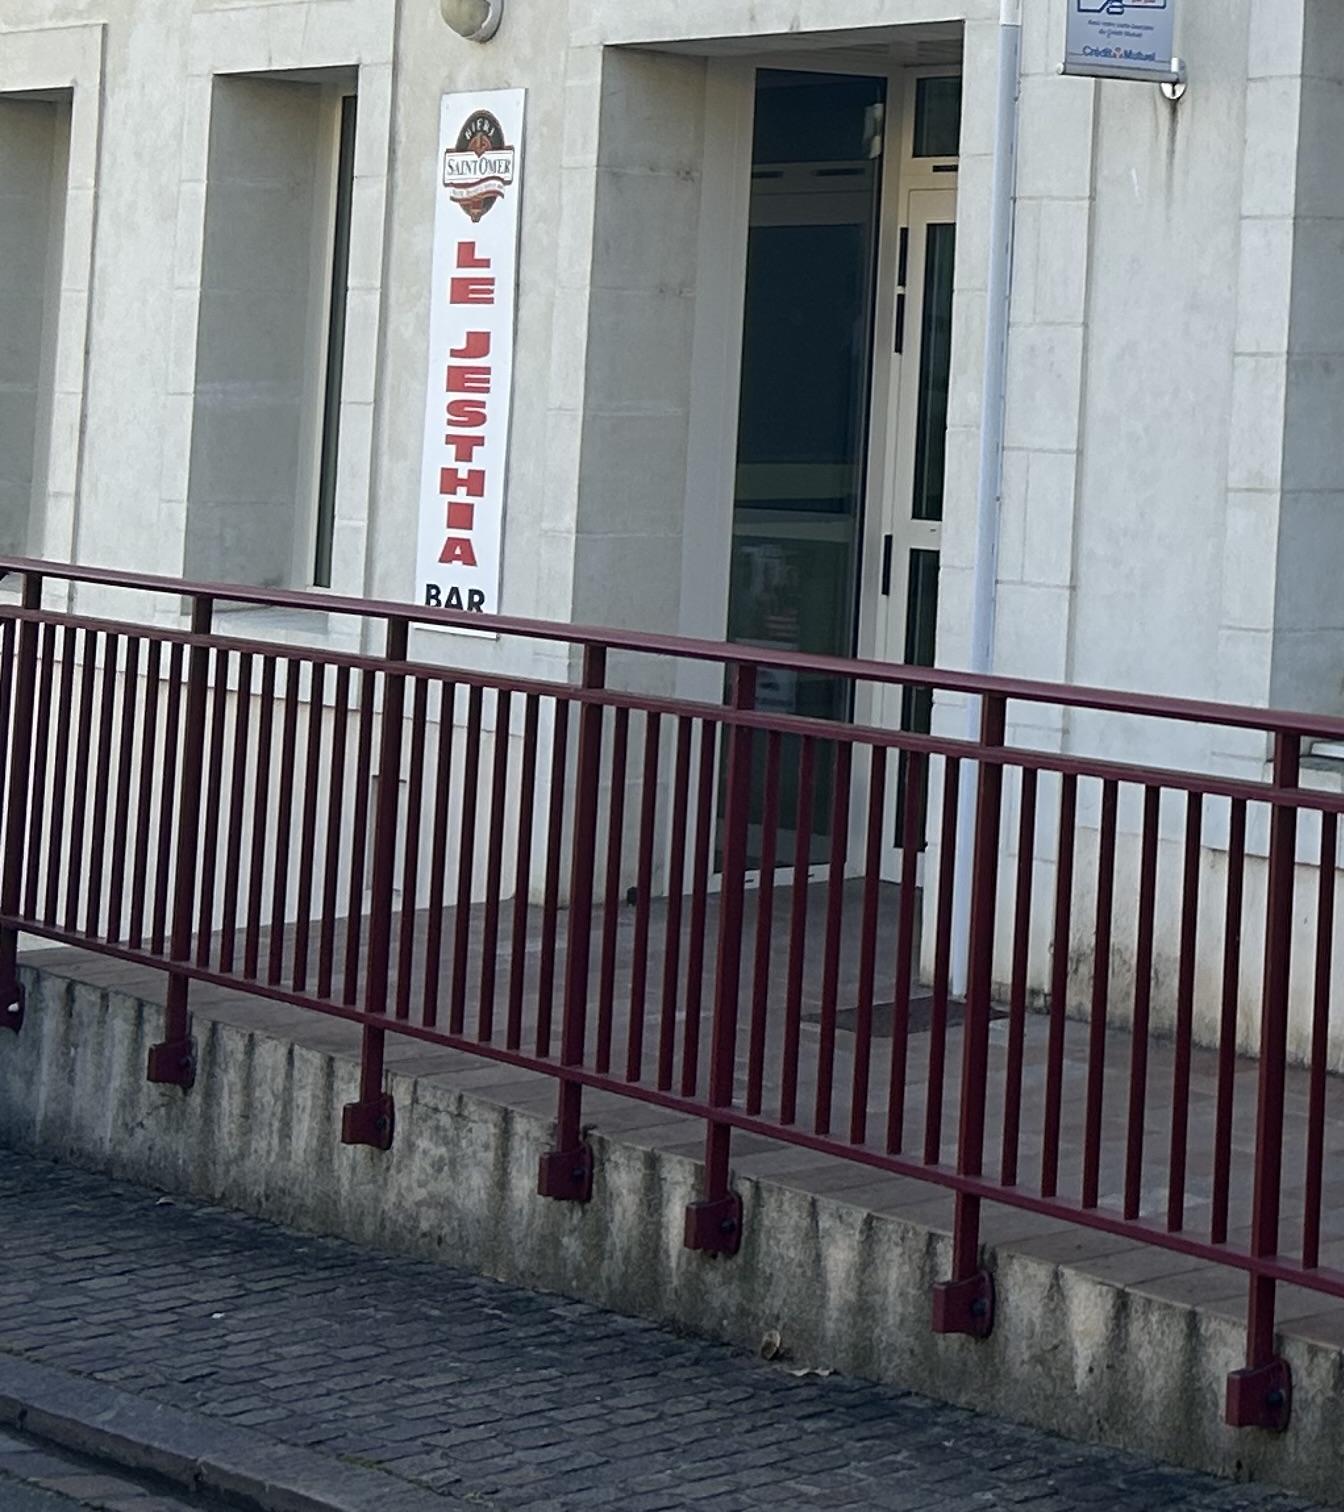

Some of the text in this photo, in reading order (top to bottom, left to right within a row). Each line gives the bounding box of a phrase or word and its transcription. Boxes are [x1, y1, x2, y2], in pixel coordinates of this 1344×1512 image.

[449, 240, 496, 305] LE
[437, 330, 492, 568] JESTHIA
[424, 583, 486, 614] BAR
